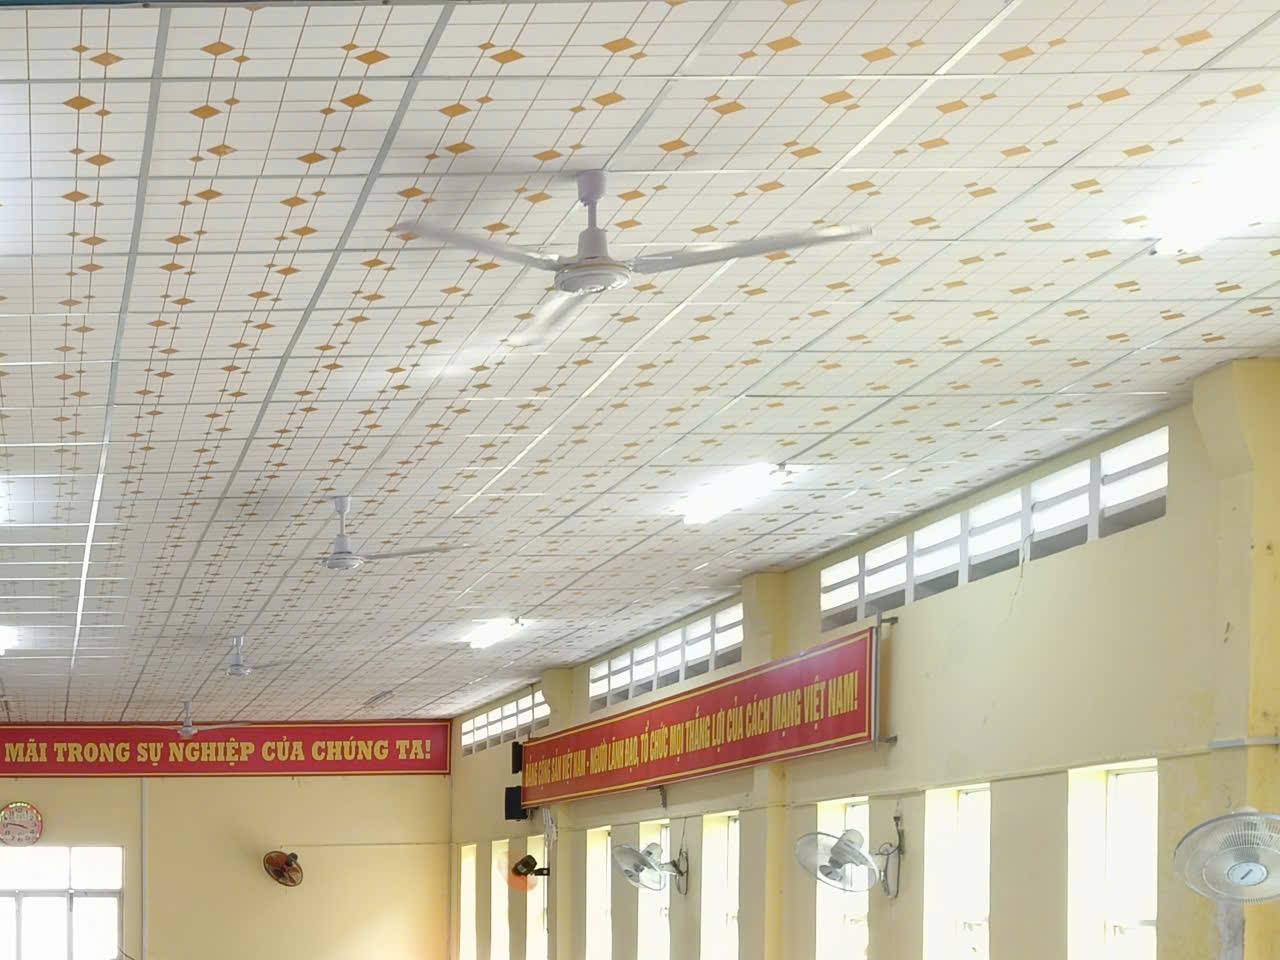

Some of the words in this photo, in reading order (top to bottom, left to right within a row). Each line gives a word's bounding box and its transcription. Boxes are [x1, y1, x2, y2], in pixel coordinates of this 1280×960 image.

[650, 722, 669, 761] CHỨC
[669, 722, 684, 762] MỌI
[685, 705, 710, 753] THẮNG
[712, 707, 725, 752] LỢI
[726, 696, 744, 743] CỦA
[745, 694, 770, 738] CÁCH
[772, 688, 801, 737] MẠNG
[804, 674, 826, 730] VIỆT
[828, 670, 858, 718] NAM!
[4, 738, 48, 763] MÃI
[53, 742, 131, 763] TRONG
[137, 742, 164, 767] SỰ
[168, 736, 255, 766] NGHIỆP
[261, 735, 305, 761] CỦA
[311, 735, 389, 761] CHÚNG
[396, 739, 431, 760] TA!
